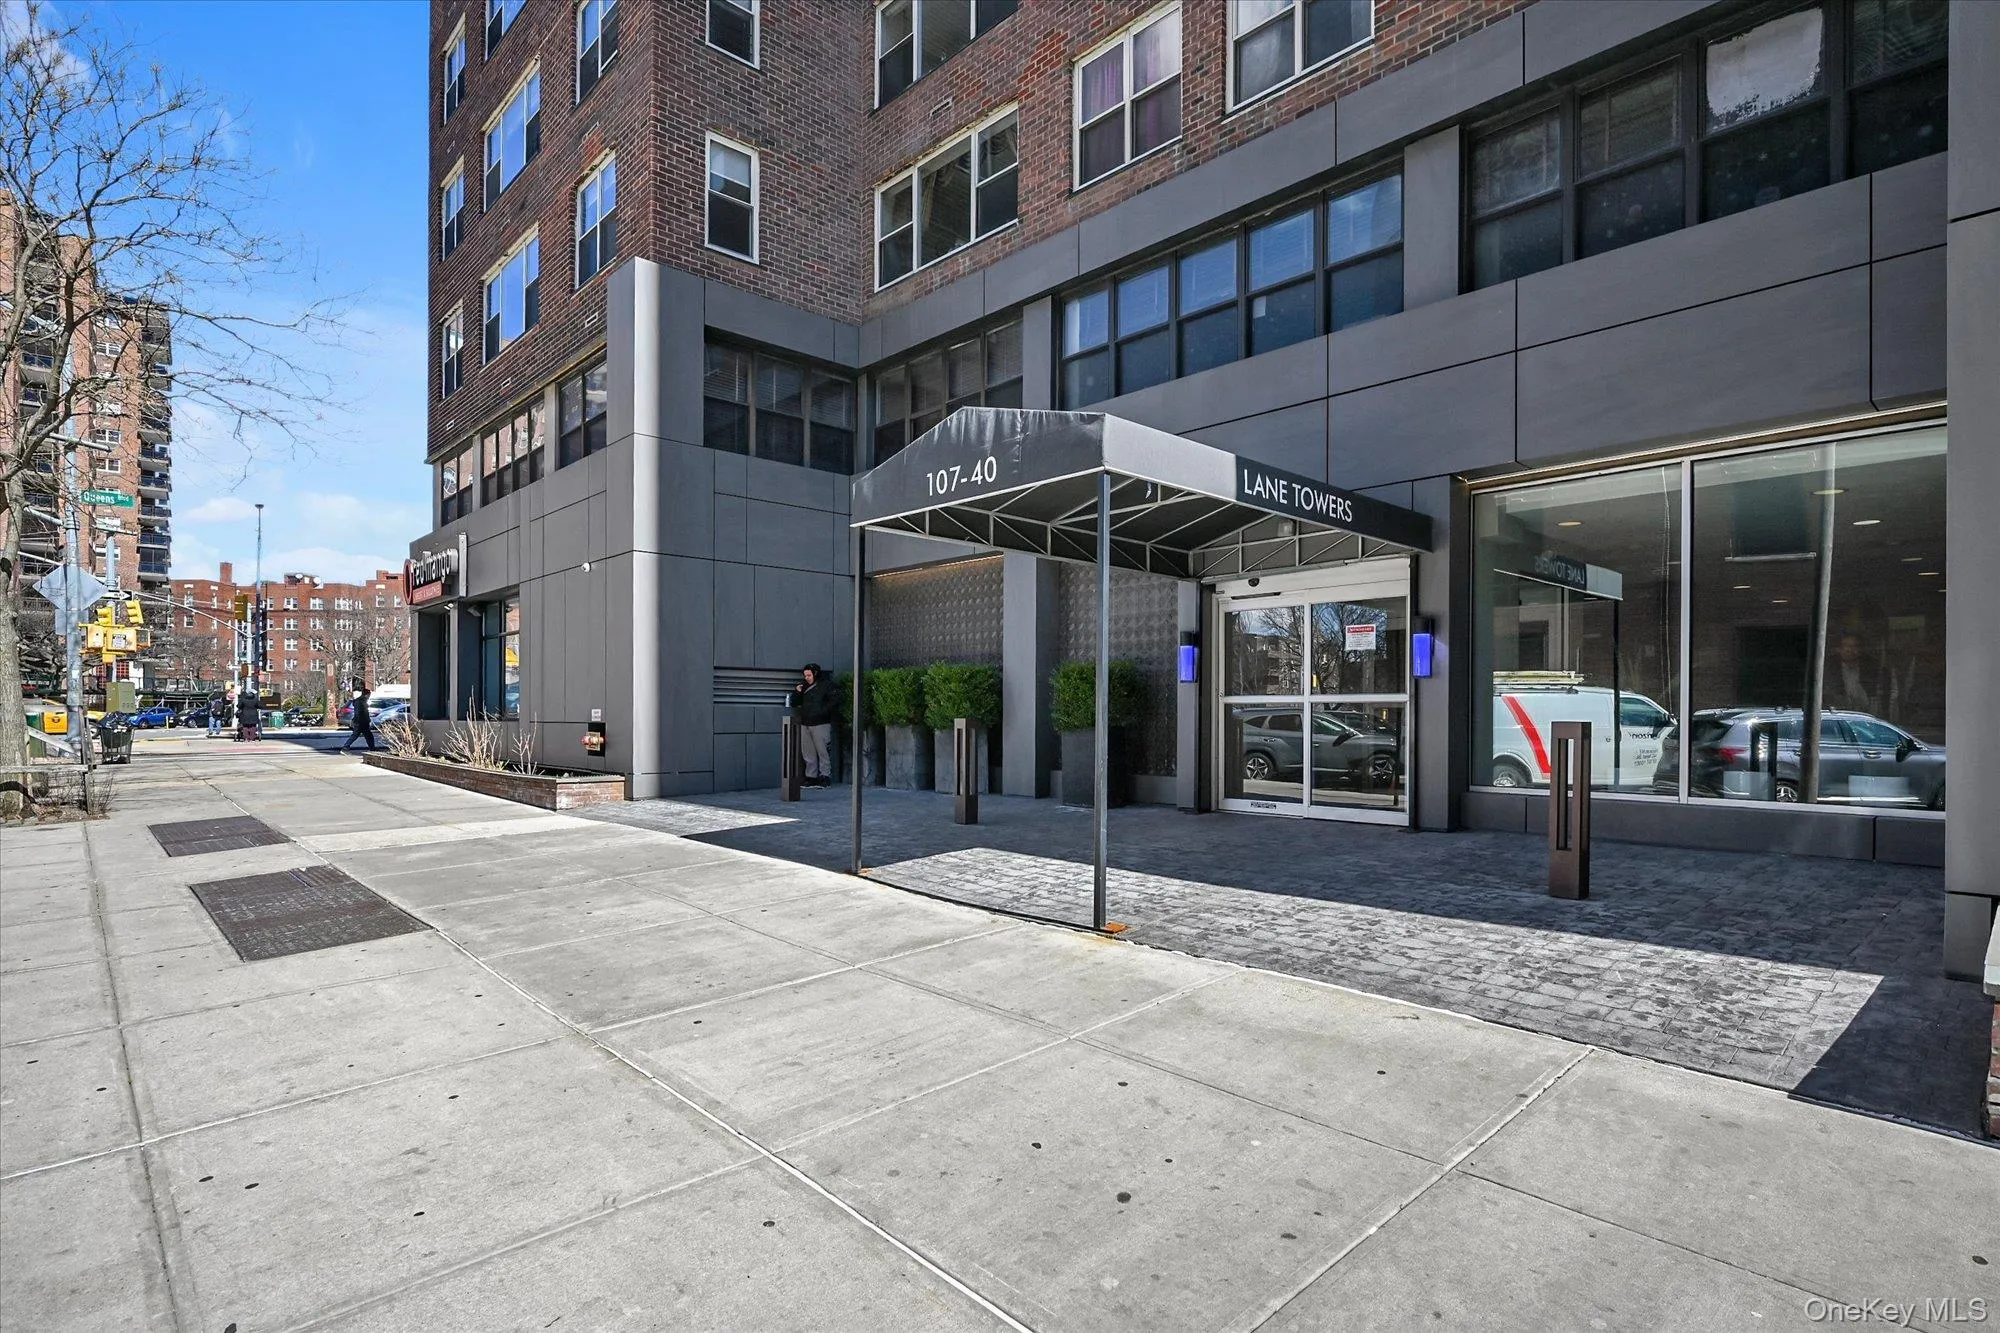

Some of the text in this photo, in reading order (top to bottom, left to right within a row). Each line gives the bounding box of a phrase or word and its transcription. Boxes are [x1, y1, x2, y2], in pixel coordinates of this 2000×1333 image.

[926, 456, 997, 496] 107-40
[1243, 469, 1353, 523] LANE TOWERS
[83, 491, 115, 504] Queens
